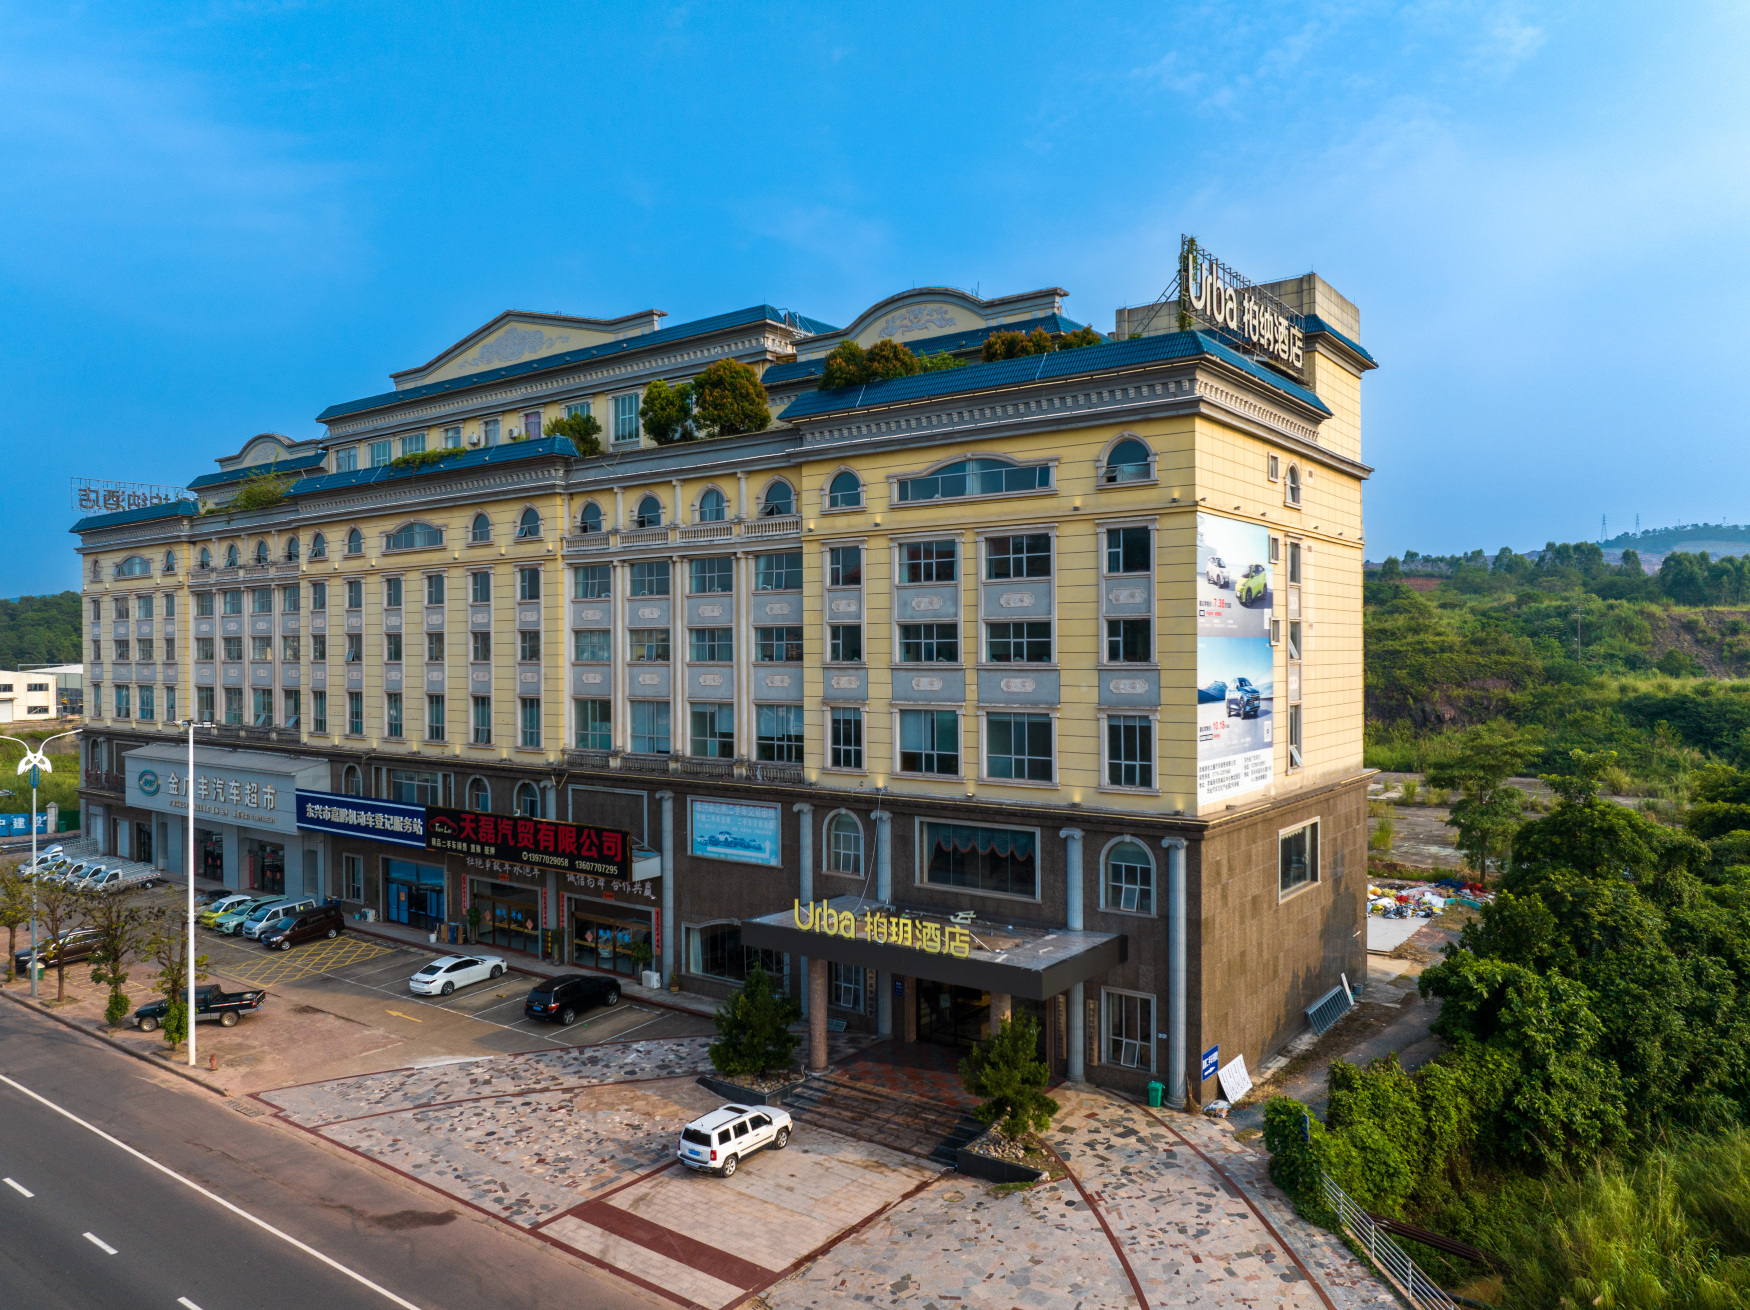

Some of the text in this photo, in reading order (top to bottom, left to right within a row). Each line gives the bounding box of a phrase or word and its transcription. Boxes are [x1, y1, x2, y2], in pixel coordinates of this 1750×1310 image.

[1188, 252, 1303, 368] Urba 柏纳酒店
[305, 803, 423, 836] 东兴市嘉鹏机动车登记服务站
[460, 813, 622, 862] 天磊汽贸有限公司
[528, 852, 618, 875] 13977029058 13607707295
[794, 898, 856, 939] Urba
